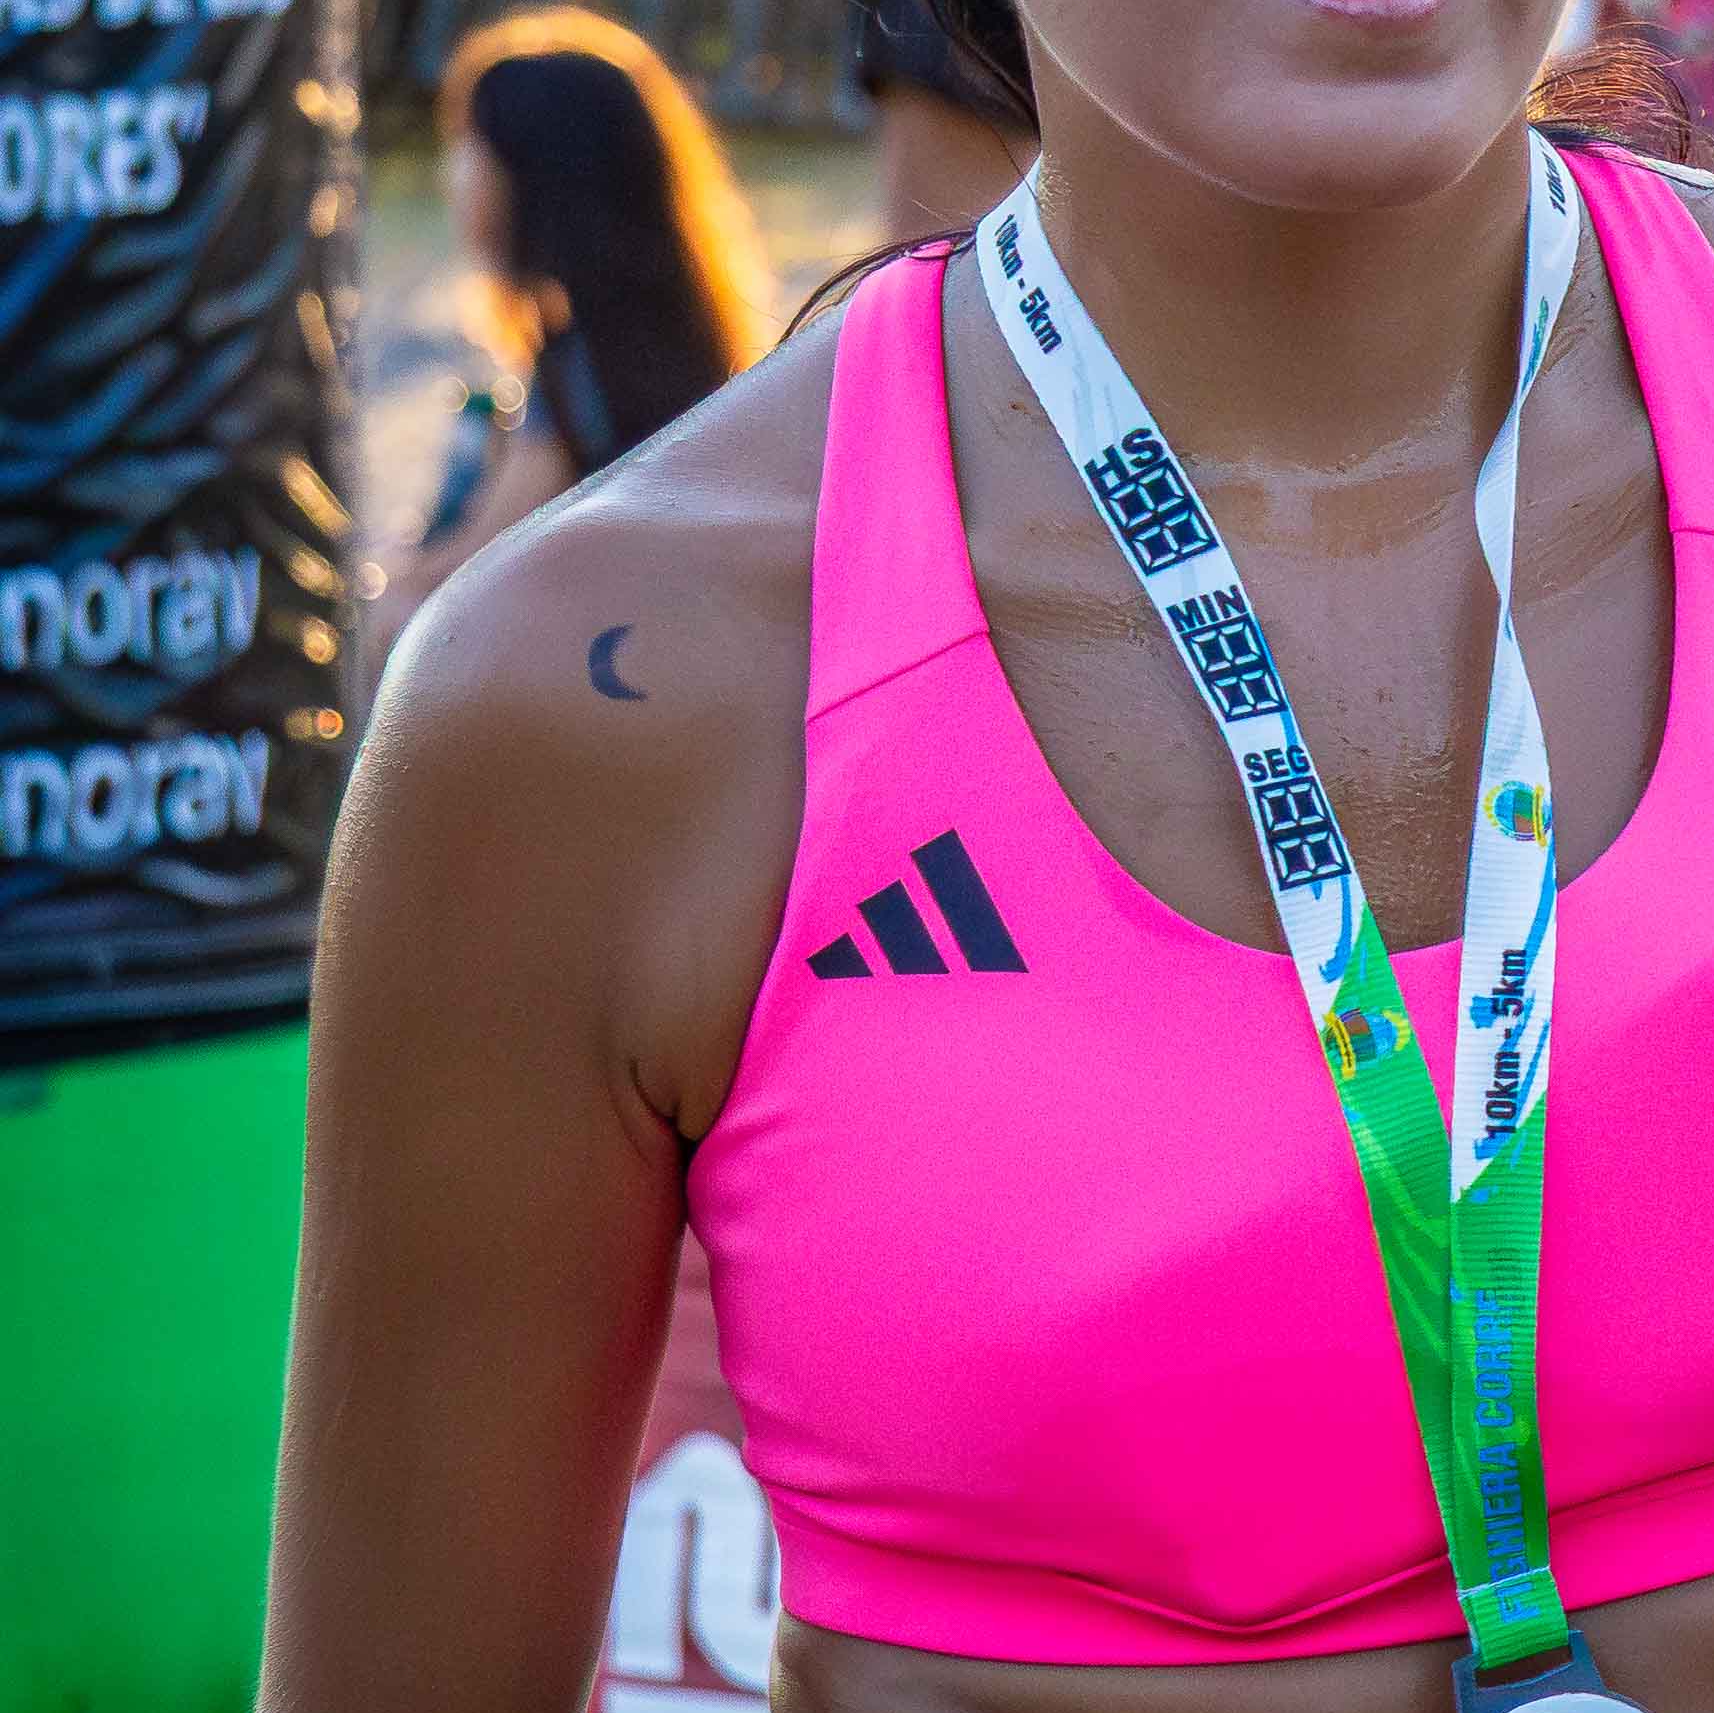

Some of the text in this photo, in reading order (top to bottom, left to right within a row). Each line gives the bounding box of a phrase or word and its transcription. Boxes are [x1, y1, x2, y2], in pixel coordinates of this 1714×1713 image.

[1019, 286, 1062, 355] 5km
[1085, 428, 1164, 498] HS
[1165, 585, 1247, 633] MIN
[1243, 745, 1311, 782] SEG
[1492, 949, 1527, 1017] 5km
[1485, 1051, 1521, 1139] 10km
[1478, 1440, 1542, 1625] FIGHIERA
